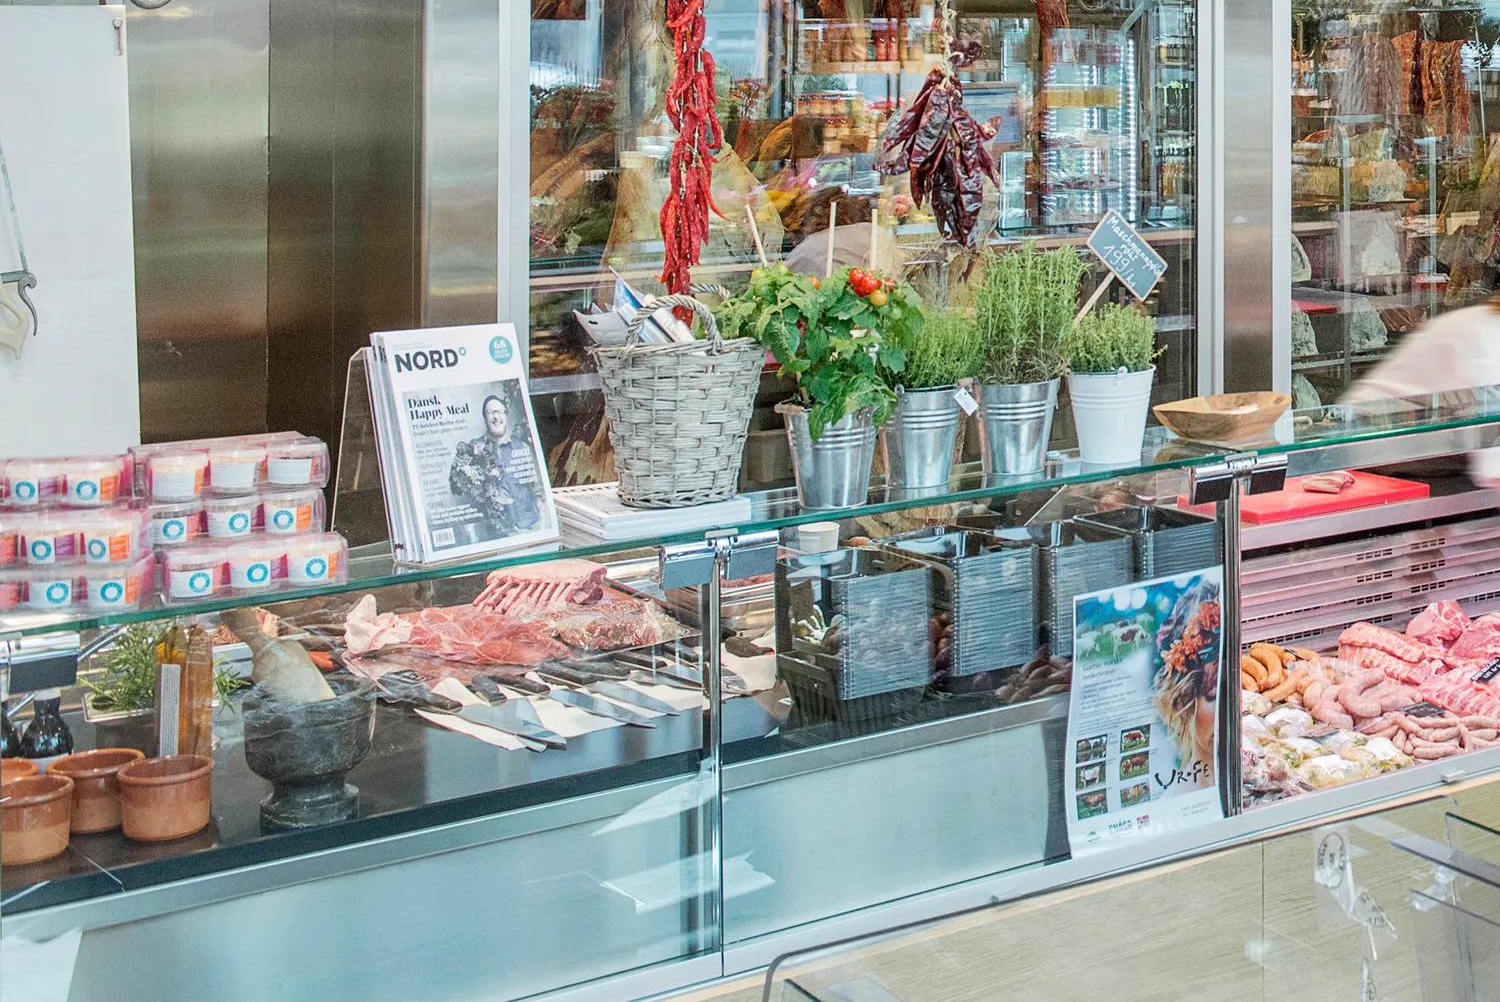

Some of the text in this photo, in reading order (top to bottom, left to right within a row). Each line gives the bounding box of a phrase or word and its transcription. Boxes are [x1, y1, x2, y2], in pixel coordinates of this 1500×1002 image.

[408, 394, 441, 409] Dansk
[410, 403, 470, 421] Happy Meal
